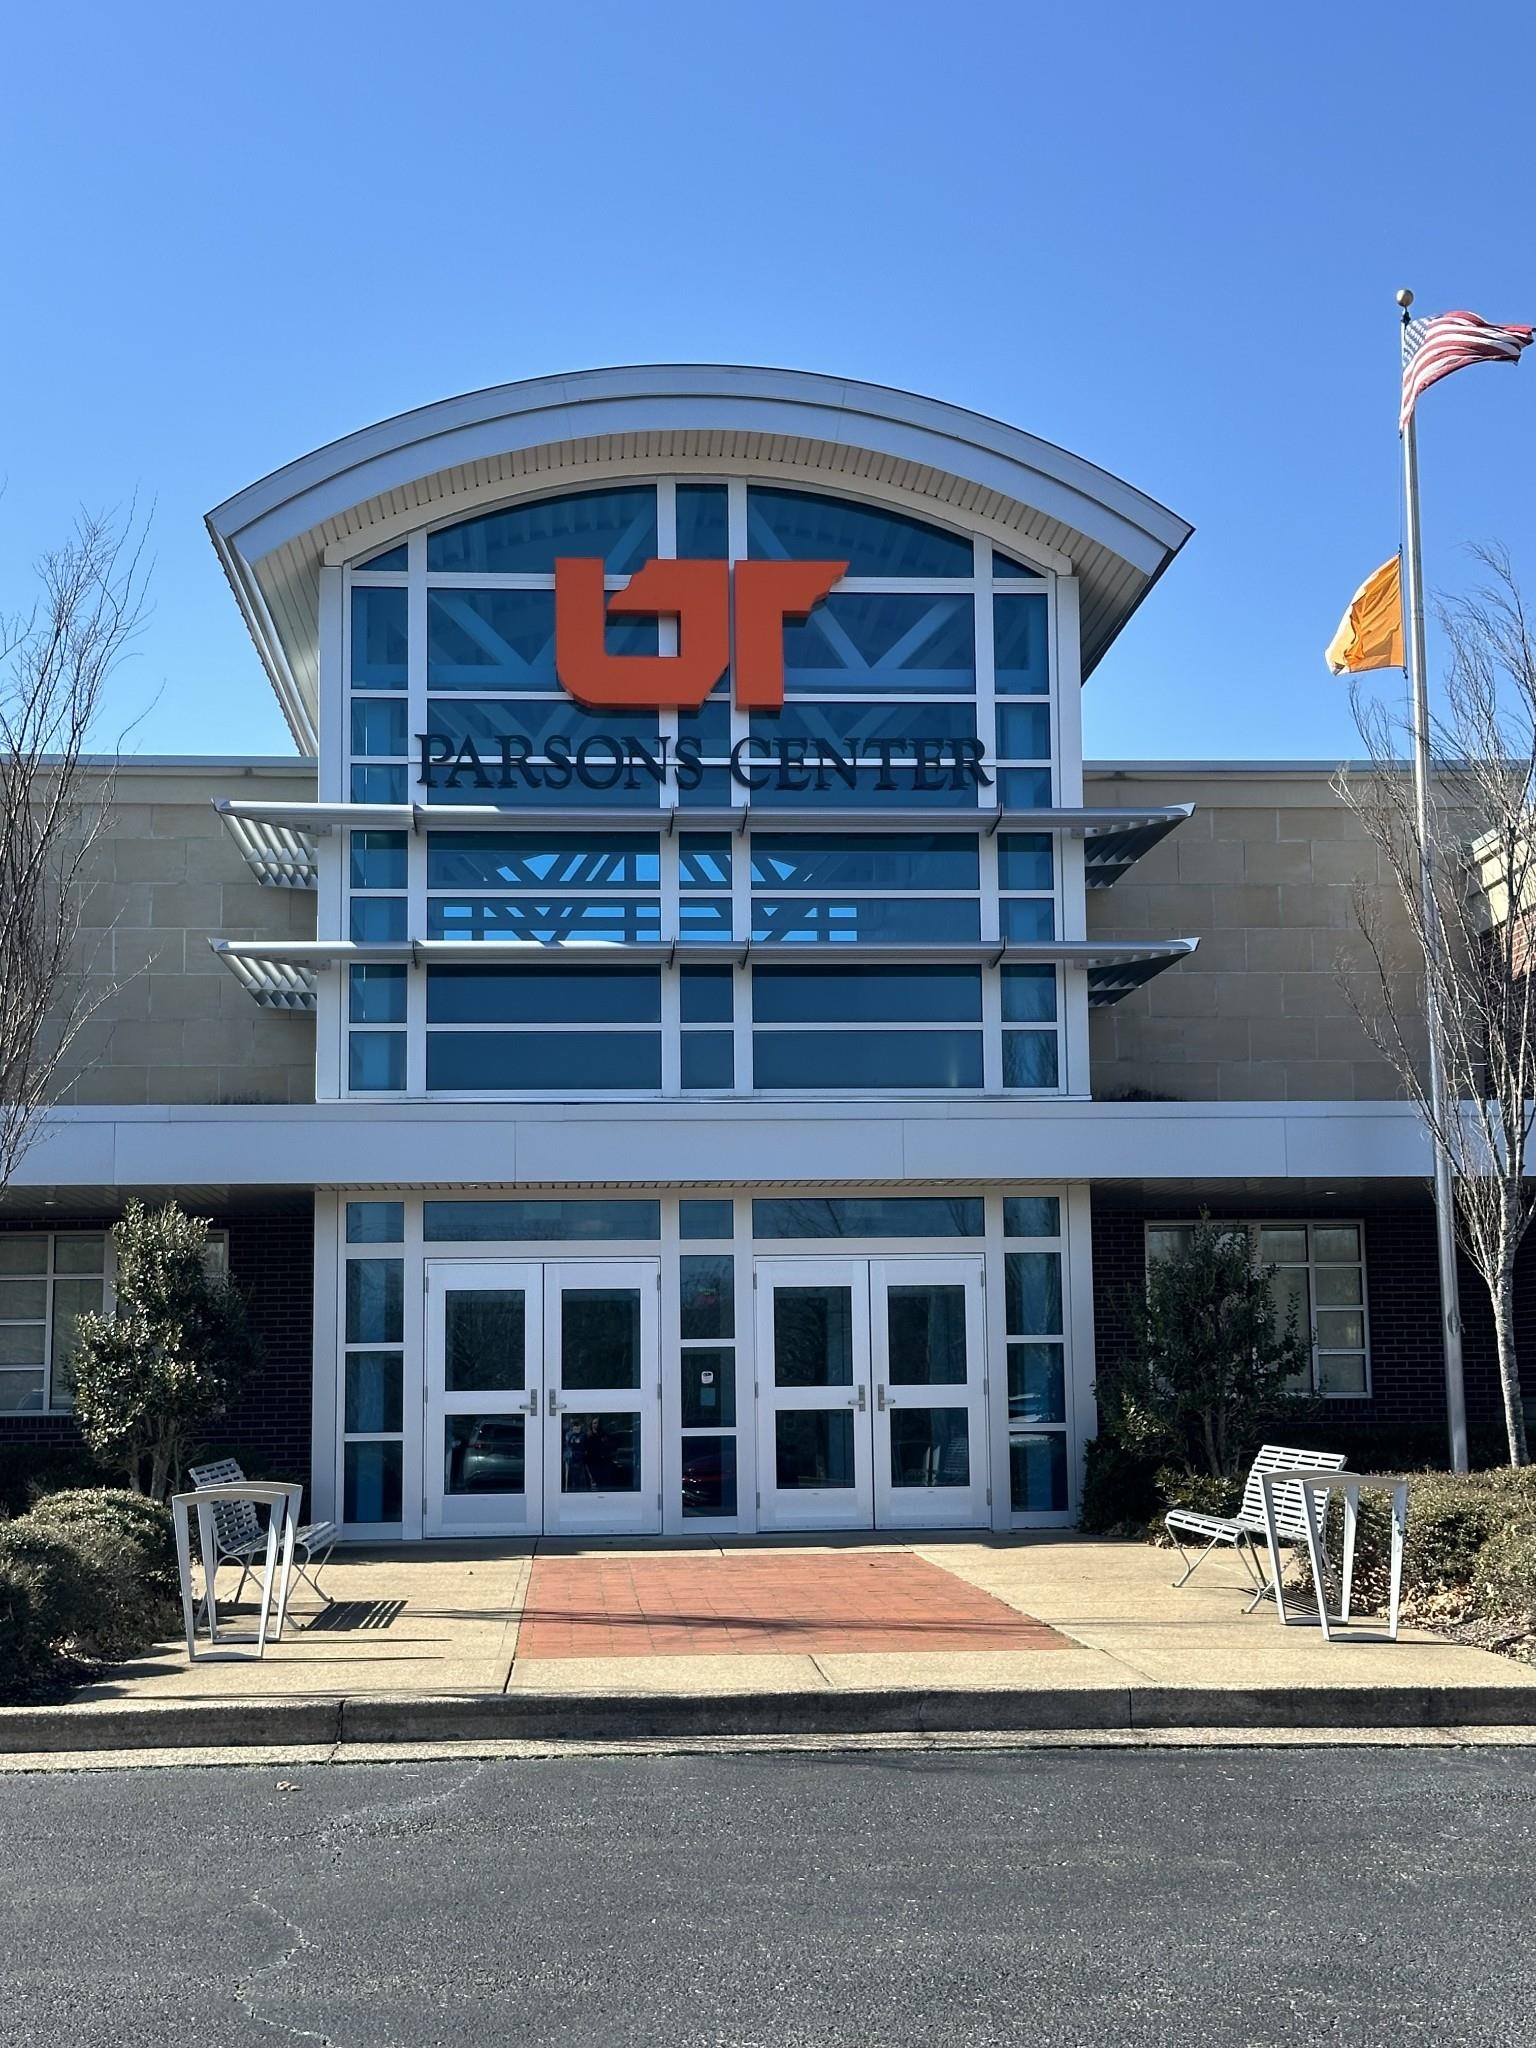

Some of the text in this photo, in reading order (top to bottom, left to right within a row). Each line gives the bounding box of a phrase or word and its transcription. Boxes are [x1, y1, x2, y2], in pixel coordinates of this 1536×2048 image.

[555, 557, 850, 711] UT
[415, 734, 994, 791] PARSONS CENTER
